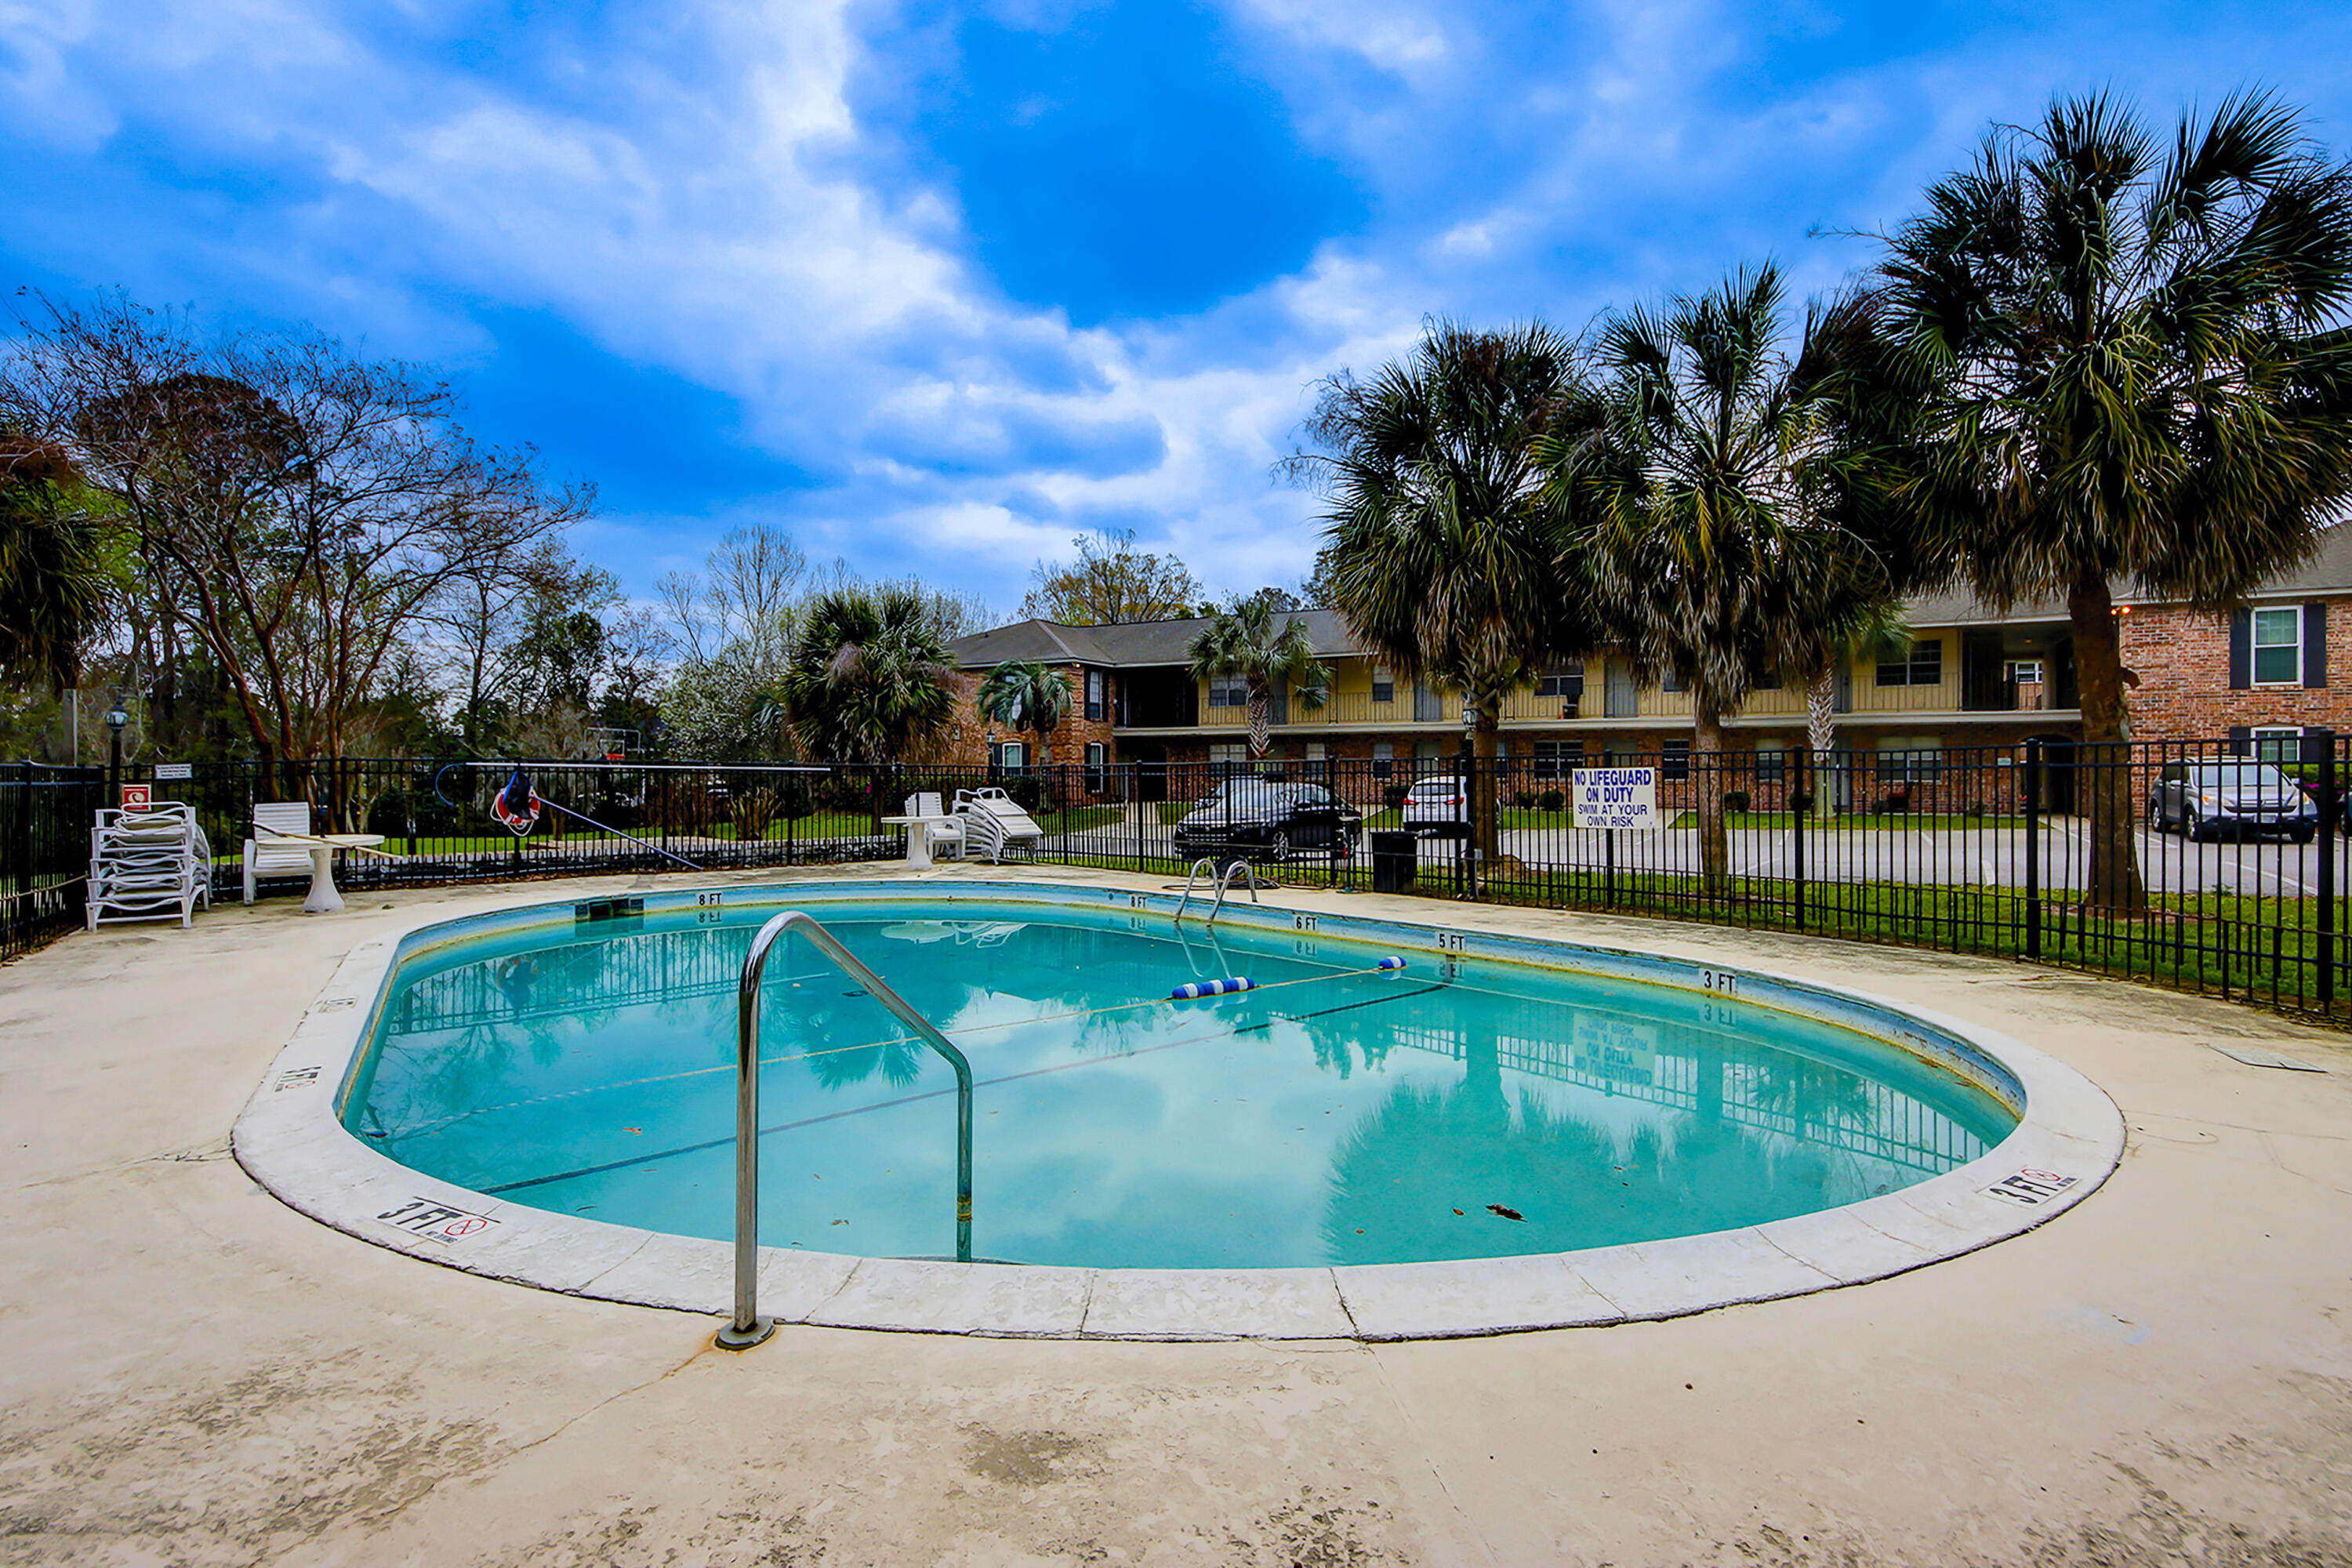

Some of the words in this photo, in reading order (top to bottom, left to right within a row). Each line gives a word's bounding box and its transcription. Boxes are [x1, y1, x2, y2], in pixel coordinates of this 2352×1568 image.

[1574, 771, 1586, 786] NO
[1589, 770, 1652, 786] LIFEGUARD
[1586, 787, 1599, 803] ON
[1604, 787, 1634, 803] DUTY
[1578, 804, 1598, 815] SWIM
[1602, 804, 1613, 815] AT
[1618, 804, 1648, 815] YOUR
[1587, 815, 1607, 826] OWN
[1611, 816, 1634, 827] RISK
[699, 894, 706, 906] 8
[710, 893, 722, 905] FT
[1138, 896, 1146, 909] FT
[1296, 916, 1302, 929] 6
[1305, 916, 1316, 931] FT
[1439, 933, 1446, 948] 5
[1450, 935, 1465, 950] FT
[1704, 971, 1711, 988] 3
[1719, 973, 1735, 993] FT
[2002, 1175, 2059, 1196] FT
[1989, 1188, 2038, 1203] 3
[377, 1202, 425, 1219] 3
[396, 1207, 463, 1230] FT
